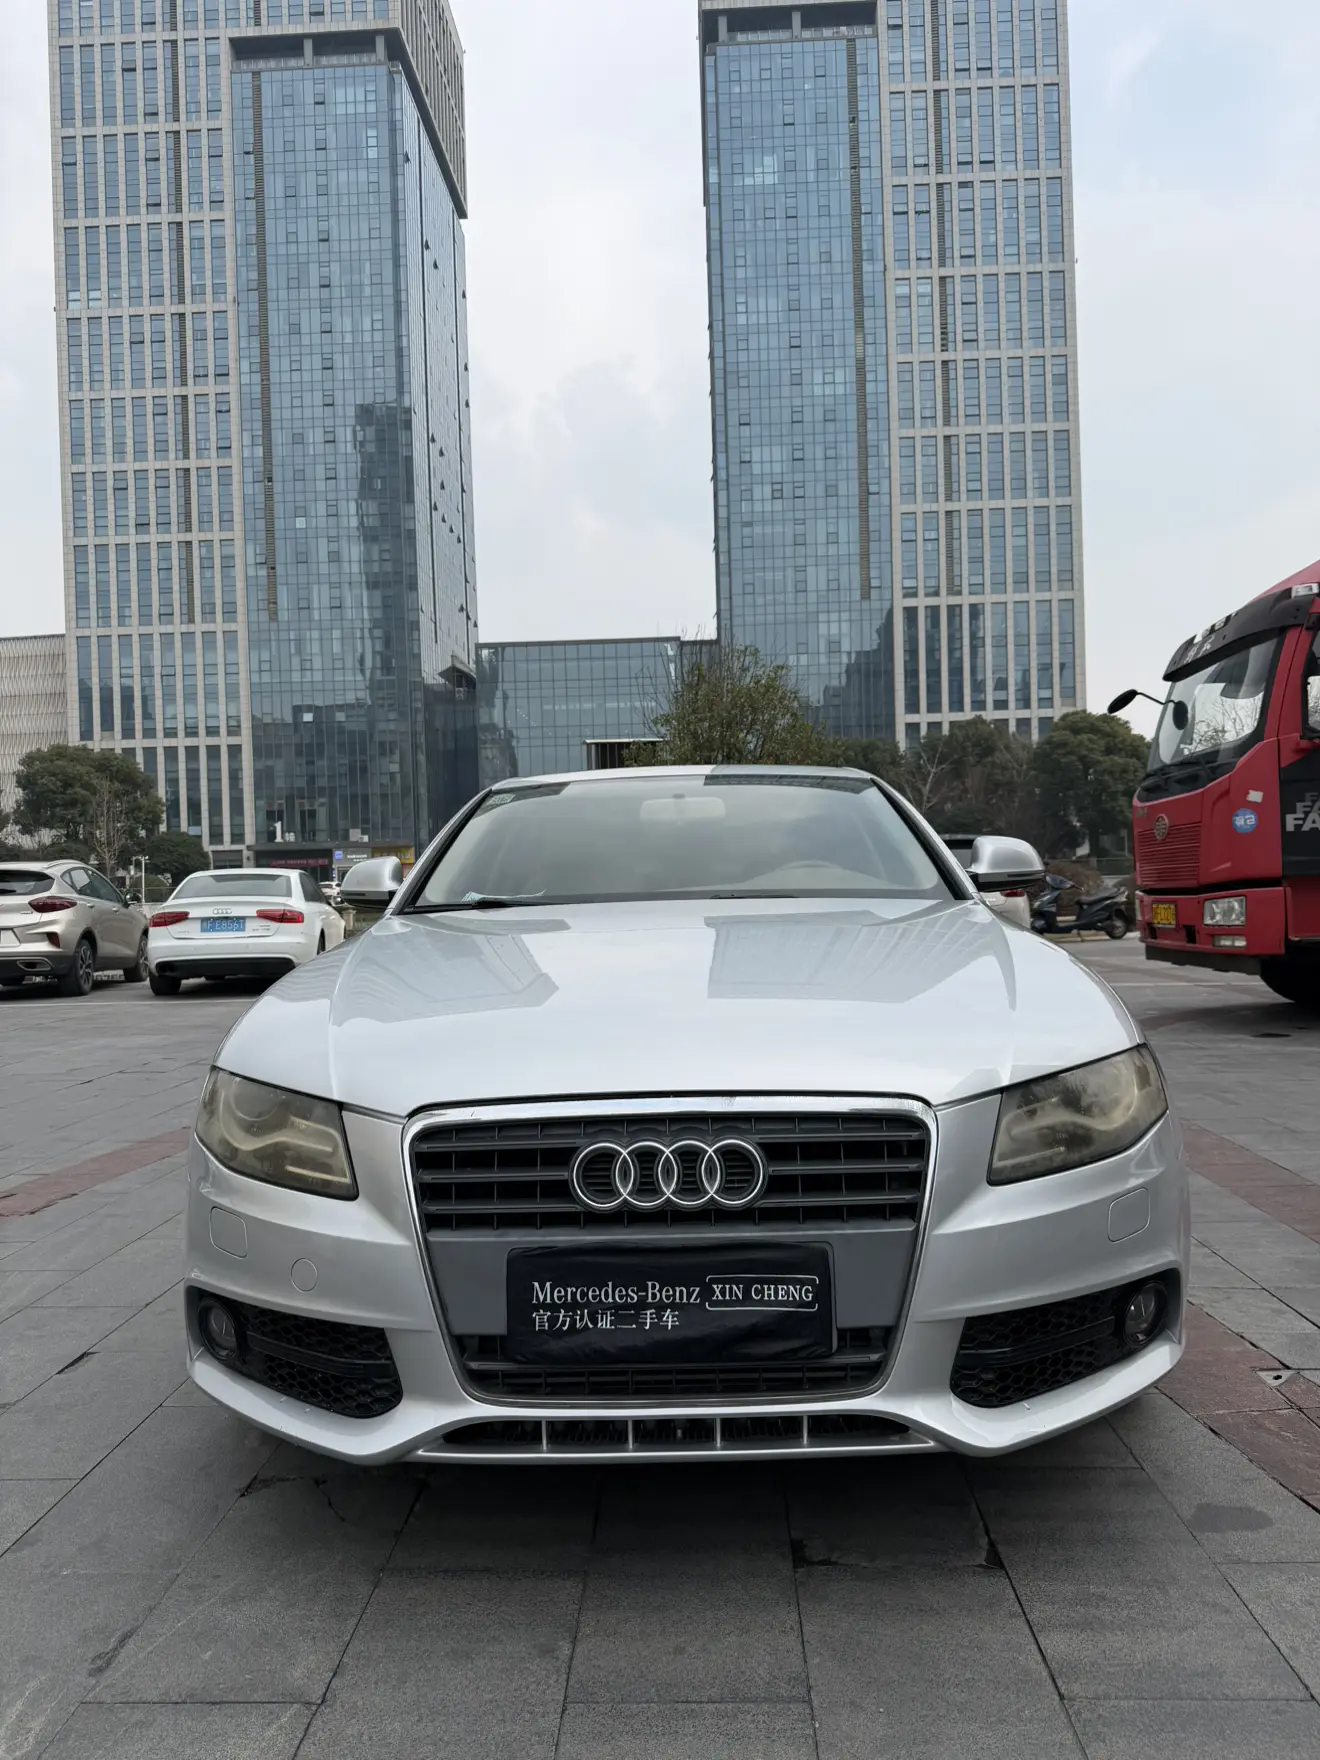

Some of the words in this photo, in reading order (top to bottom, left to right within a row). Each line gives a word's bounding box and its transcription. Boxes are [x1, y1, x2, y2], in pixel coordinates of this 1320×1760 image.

[531, 1281, 701, 1304] Mercedes-Benz
[711, 1284, 744, 1301] XIN
[751, 1283, 814, 1302] CHENG
[532, 1308, 680, 1331] 官方认证二手车
